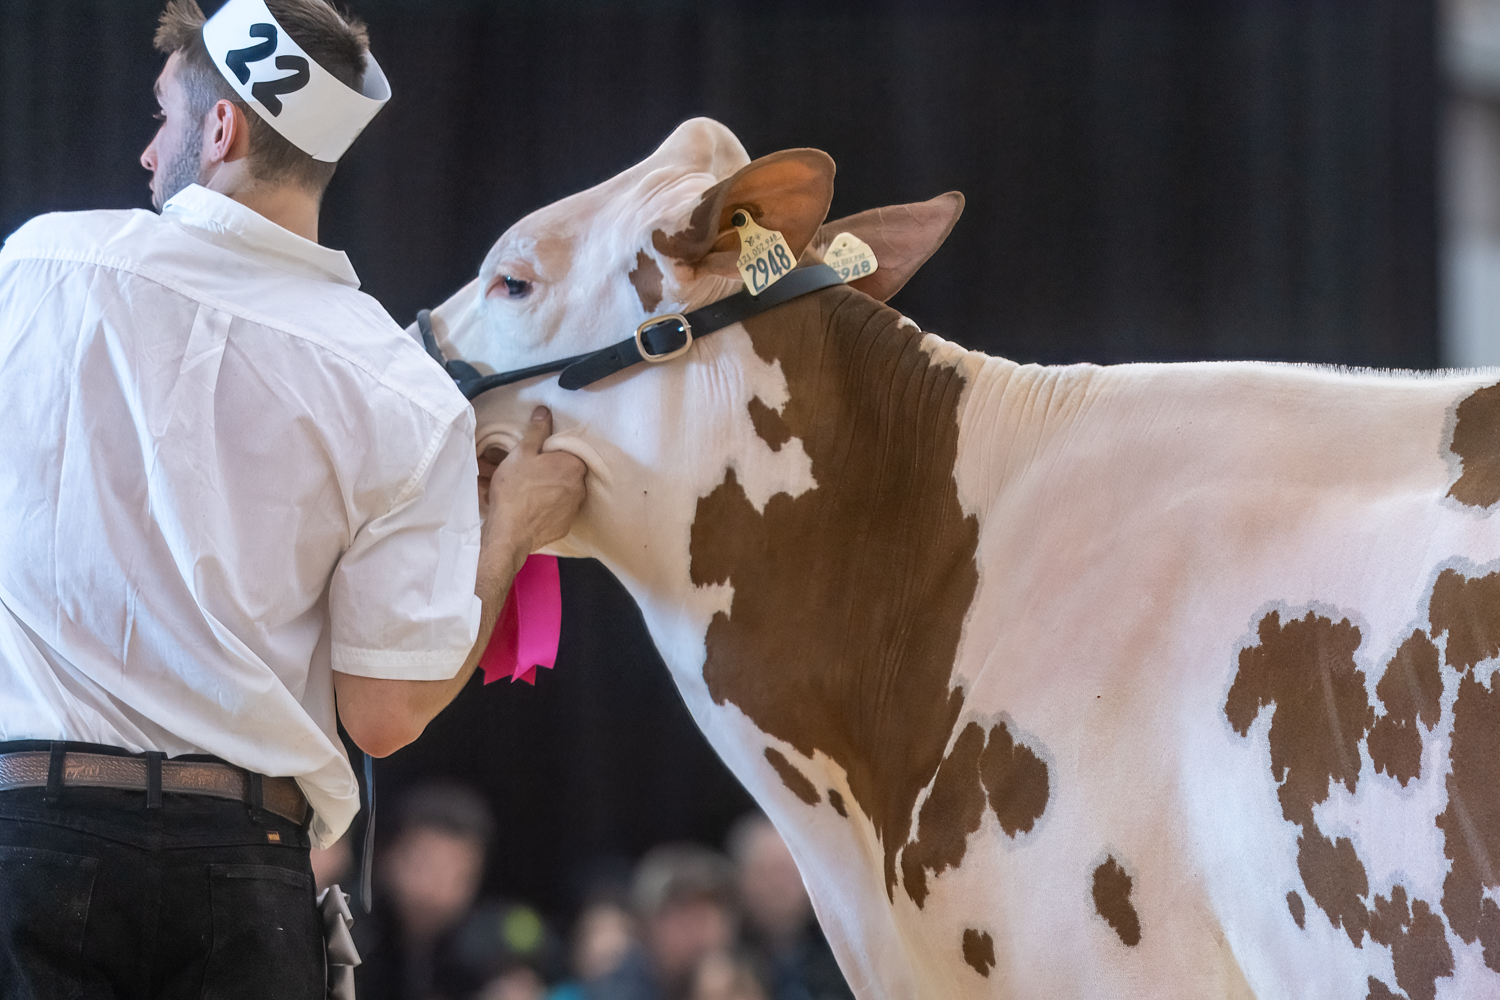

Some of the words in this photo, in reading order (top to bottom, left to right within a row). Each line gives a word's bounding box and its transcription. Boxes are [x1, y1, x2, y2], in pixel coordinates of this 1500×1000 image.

[225, 23, 310, 117] 22
[745, 243, 792, 292] 2948
[836, 260, 871, 281] 948
